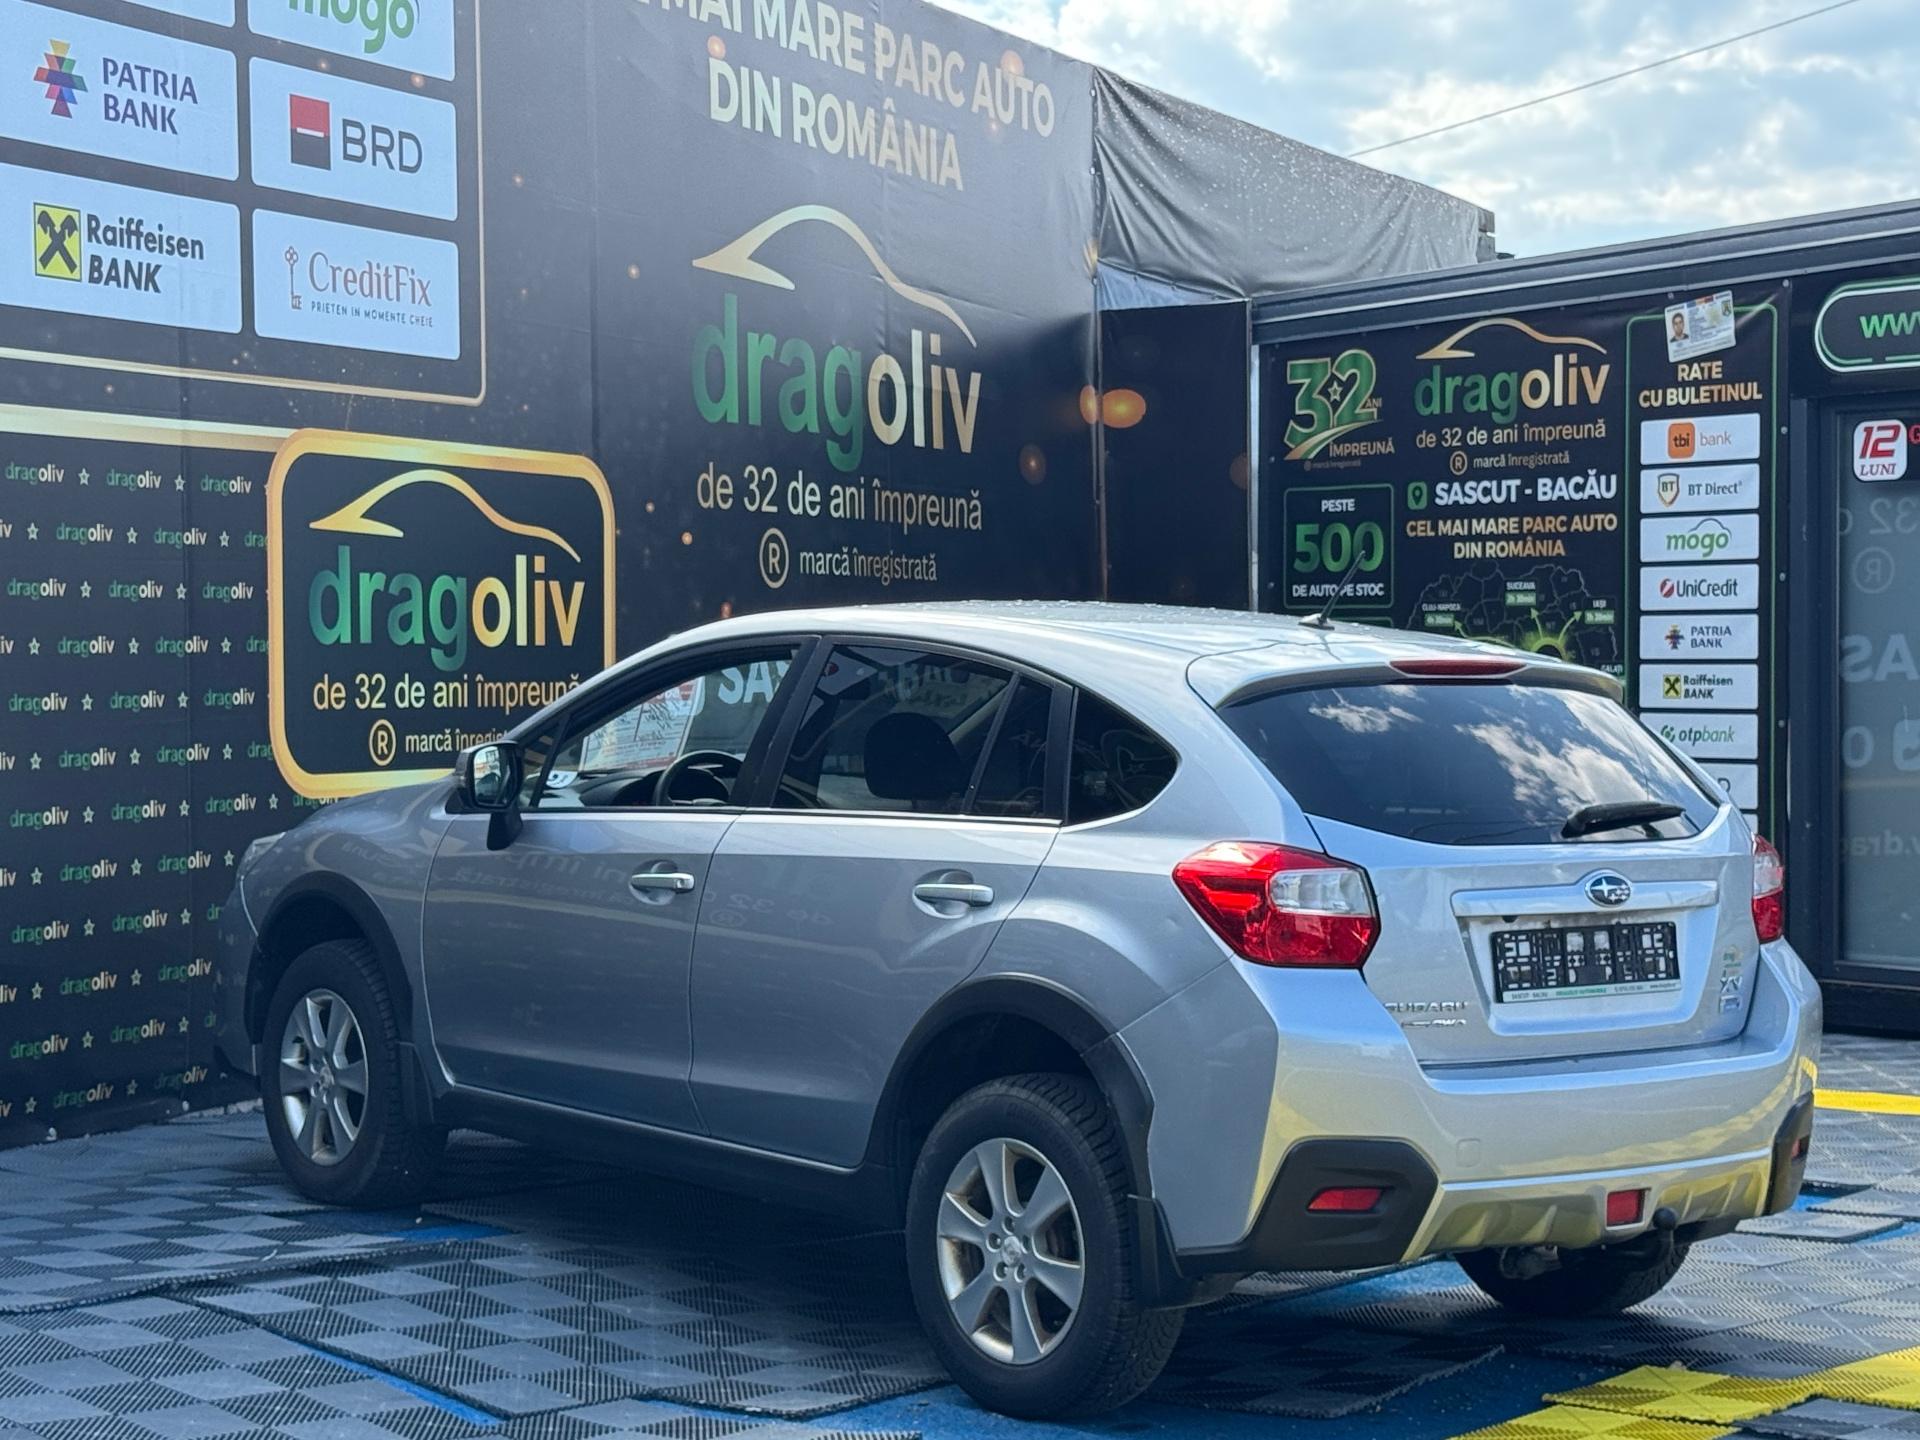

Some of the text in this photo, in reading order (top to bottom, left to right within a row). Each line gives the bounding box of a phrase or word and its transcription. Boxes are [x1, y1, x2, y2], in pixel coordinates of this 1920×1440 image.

[102, 57, 198, 104] PATRIA
[753, 0, 866, 74] MARE
[873, 22, 965, 108] PARC
[971, 62, 1055, 137] AUTO
[103, 93, 178, 135] BANK
[708, 57, 963, 190] DIN ROMÂNIA
[342, 118, 423, 174] BRD
[86, 213, 204, 260] Raiffeisen
[88, 254, 162, 293] BANK
[309, 252, 432, 307] CreditFix
[311, 301, 348, 316] PRIETEN
[364, 309, 406, 325] MOMENTE
[692, 293, 982, 472] dragoliv
[1677, 361, 1723, 382] RATE
[1284, 349, 1377, 449] 32
[1414, 353, 1610, 424] dragoliv
[1639, 382, 1762, 408] CU BULETINUL
[1416, 419, 1606, 449] de 32 de ani împreună
[1673, 429, 1731, 448] tbi bank
[1859, 425, 1900, 459] 12
[1473, 455, 1506, 469] marcă
[1508, 451, 1570, 468] înregistrată
[1860, 464, 1896, 476] LUNI
[6, 462, 64, 485] dragoliv
[106, 469, 162, 489] dragoliv
[200, 476, 251, 495] dragoliv
[697, 461, 982, 535] de 32 de ani împreună
[1435, 479, 1521, 505] SASCUT
[1537, 469, 1617, 502] BACĂU
[1662, 481, 1676, 492] BT
[1688, 485, 1703, 496] BT
[1321, 499, 1356, 512] PESTE
[56, 523, 113, 545] dragoliv
[1406, 513, 1617, 537] CEL MAI MARE PARC AUTO
[154, 528, 207, 549] dragoliv
[1293, 522, 1384, 573] 500
[1454, 539, 1565, 559] DIN ROMÂNIA
[1666, 531, 1730, 557] mogo
[799, 546, 850, 577] marcă
[852, 547, 938, 586] înregistrată
[7, 578, 66, 601] dragoliv
[108, 579, 163, 601] dragoliv
[202, 582, 253, 603] dragoliv
[1292, 585, 1307, 597] DE
[1309, 584, 1338, 597] AUTO
[1356, 583, 1384, 596] STOC
[1677, 579, 1738, 598] UniCredit
[308, 545, 585, 672] dragoliv
[1690, 626, 1732, 637] PATRIA
[1690, 637, 1723, 648] BANK
[57, 635, 115, 657] dragoliv
[155, 635, 209, 657] dragoliv
[313, 674, 347, 710] de
[355, 673, 387, 709] 32
[395, 673, 426, 709] de
[433, 674, 468, 708] ani
[1683, 675, 1733, 686] Raiffeisen
[9, 692, 68, 715] dragoliv
[110, 690, 165, 712] dragoliv
[204, 688, 255, 709] dragoliv
[1684, 689, 1714, 699] BANK
[405, 729, 453, 753] marcă
[1679, 726, 1735, 746] otpbank
[59, 748, 116, 770] dragoliv
[157, 743, 210, 765] dragoliv
[111, 799, 166, 823] dragoliv
[206, 793, 257, 816] dragoliv
[10, 806, 69, 830] dragoliv
[60, 860, 117, 884] dragoliv
[158, 851, 211, 874] dragoliv
[12, 920, 70, 945] dragoliv
[112, 910, 168, 933] dragoliv
[159, 958, 212, 982] dragoliv
[60, 971, 117, 996] dragoliv
[111, 1018, 165, 1044] dragoliv
[11, 1034, 69, 1060] dragoliv
[155, 1065, 208, 1090] dragoliv
[53, 1083, 114, 1109] dragoliv
